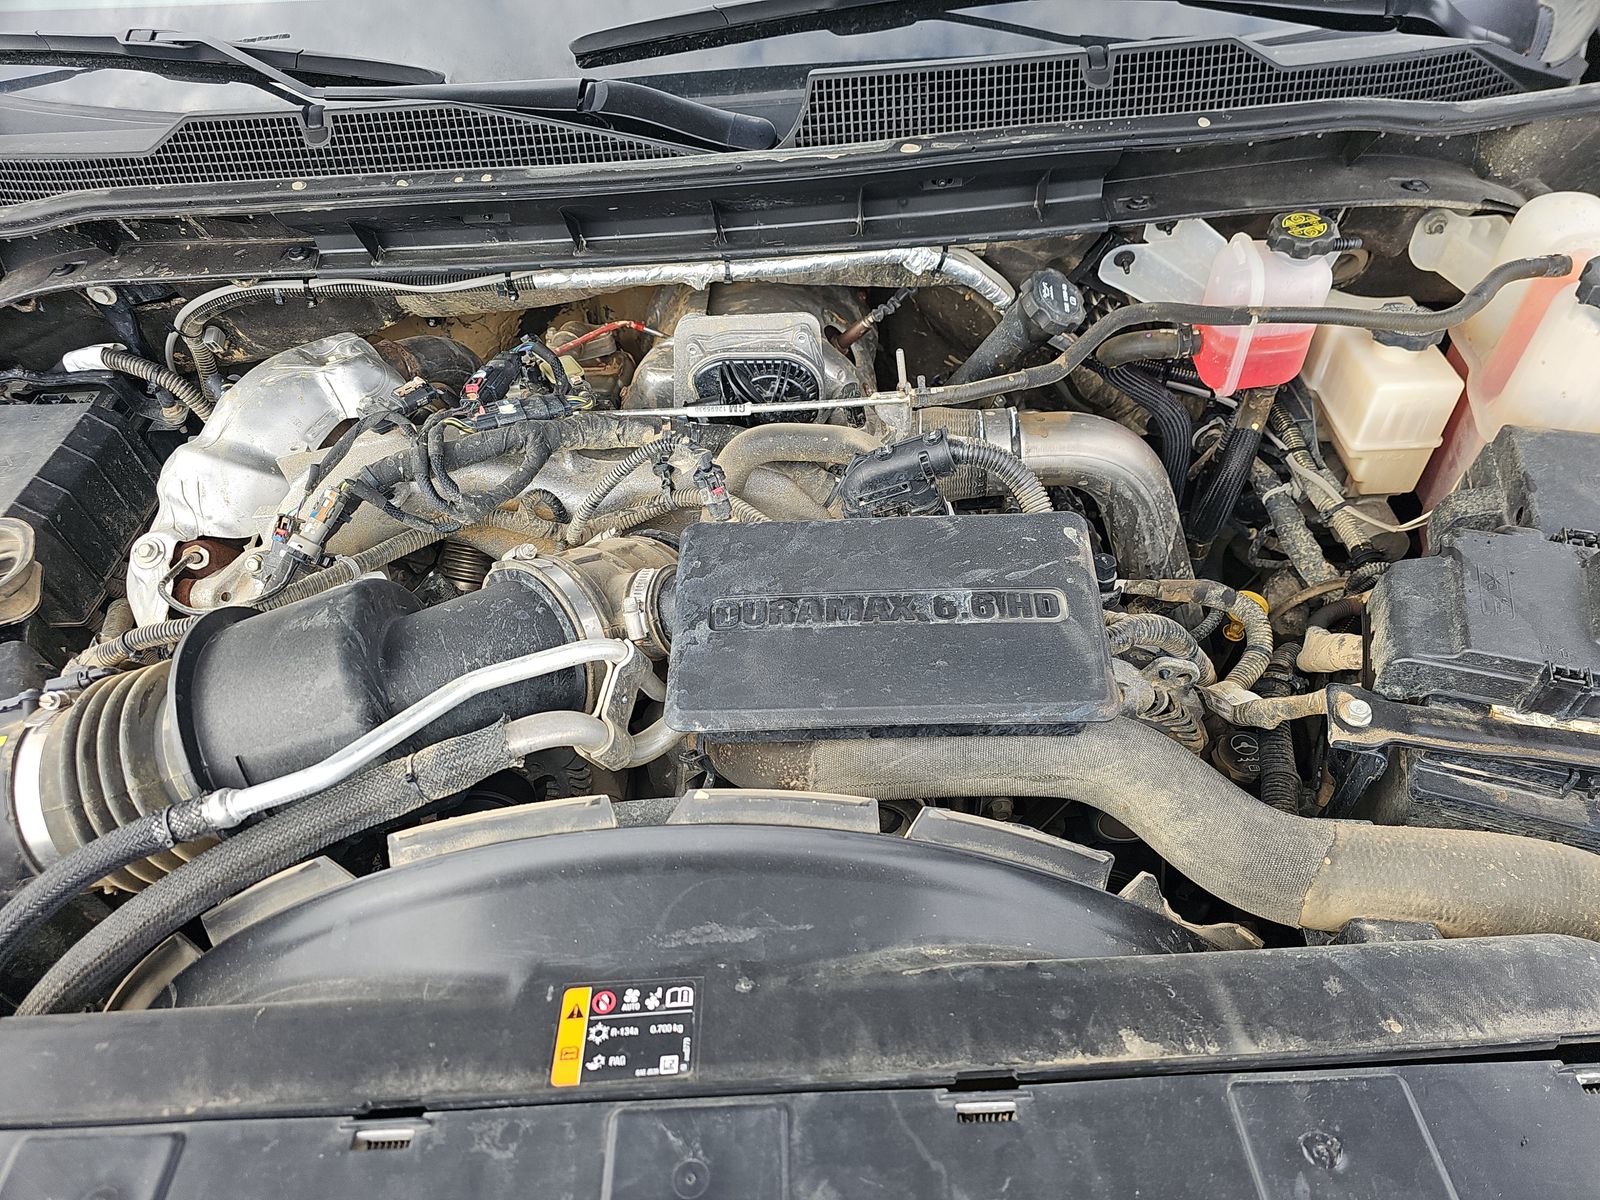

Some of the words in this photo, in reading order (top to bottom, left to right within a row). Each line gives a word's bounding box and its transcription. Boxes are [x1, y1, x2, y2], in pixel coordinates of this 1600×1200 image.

[729, 404, 746, 412] GM
[712, 595, 920, 628] DURAMAX
[931, 592, 997, 620] 6.6
[1006, 592, 1061, 619] HD
[621, 1002, 641, 1012] AUTO
